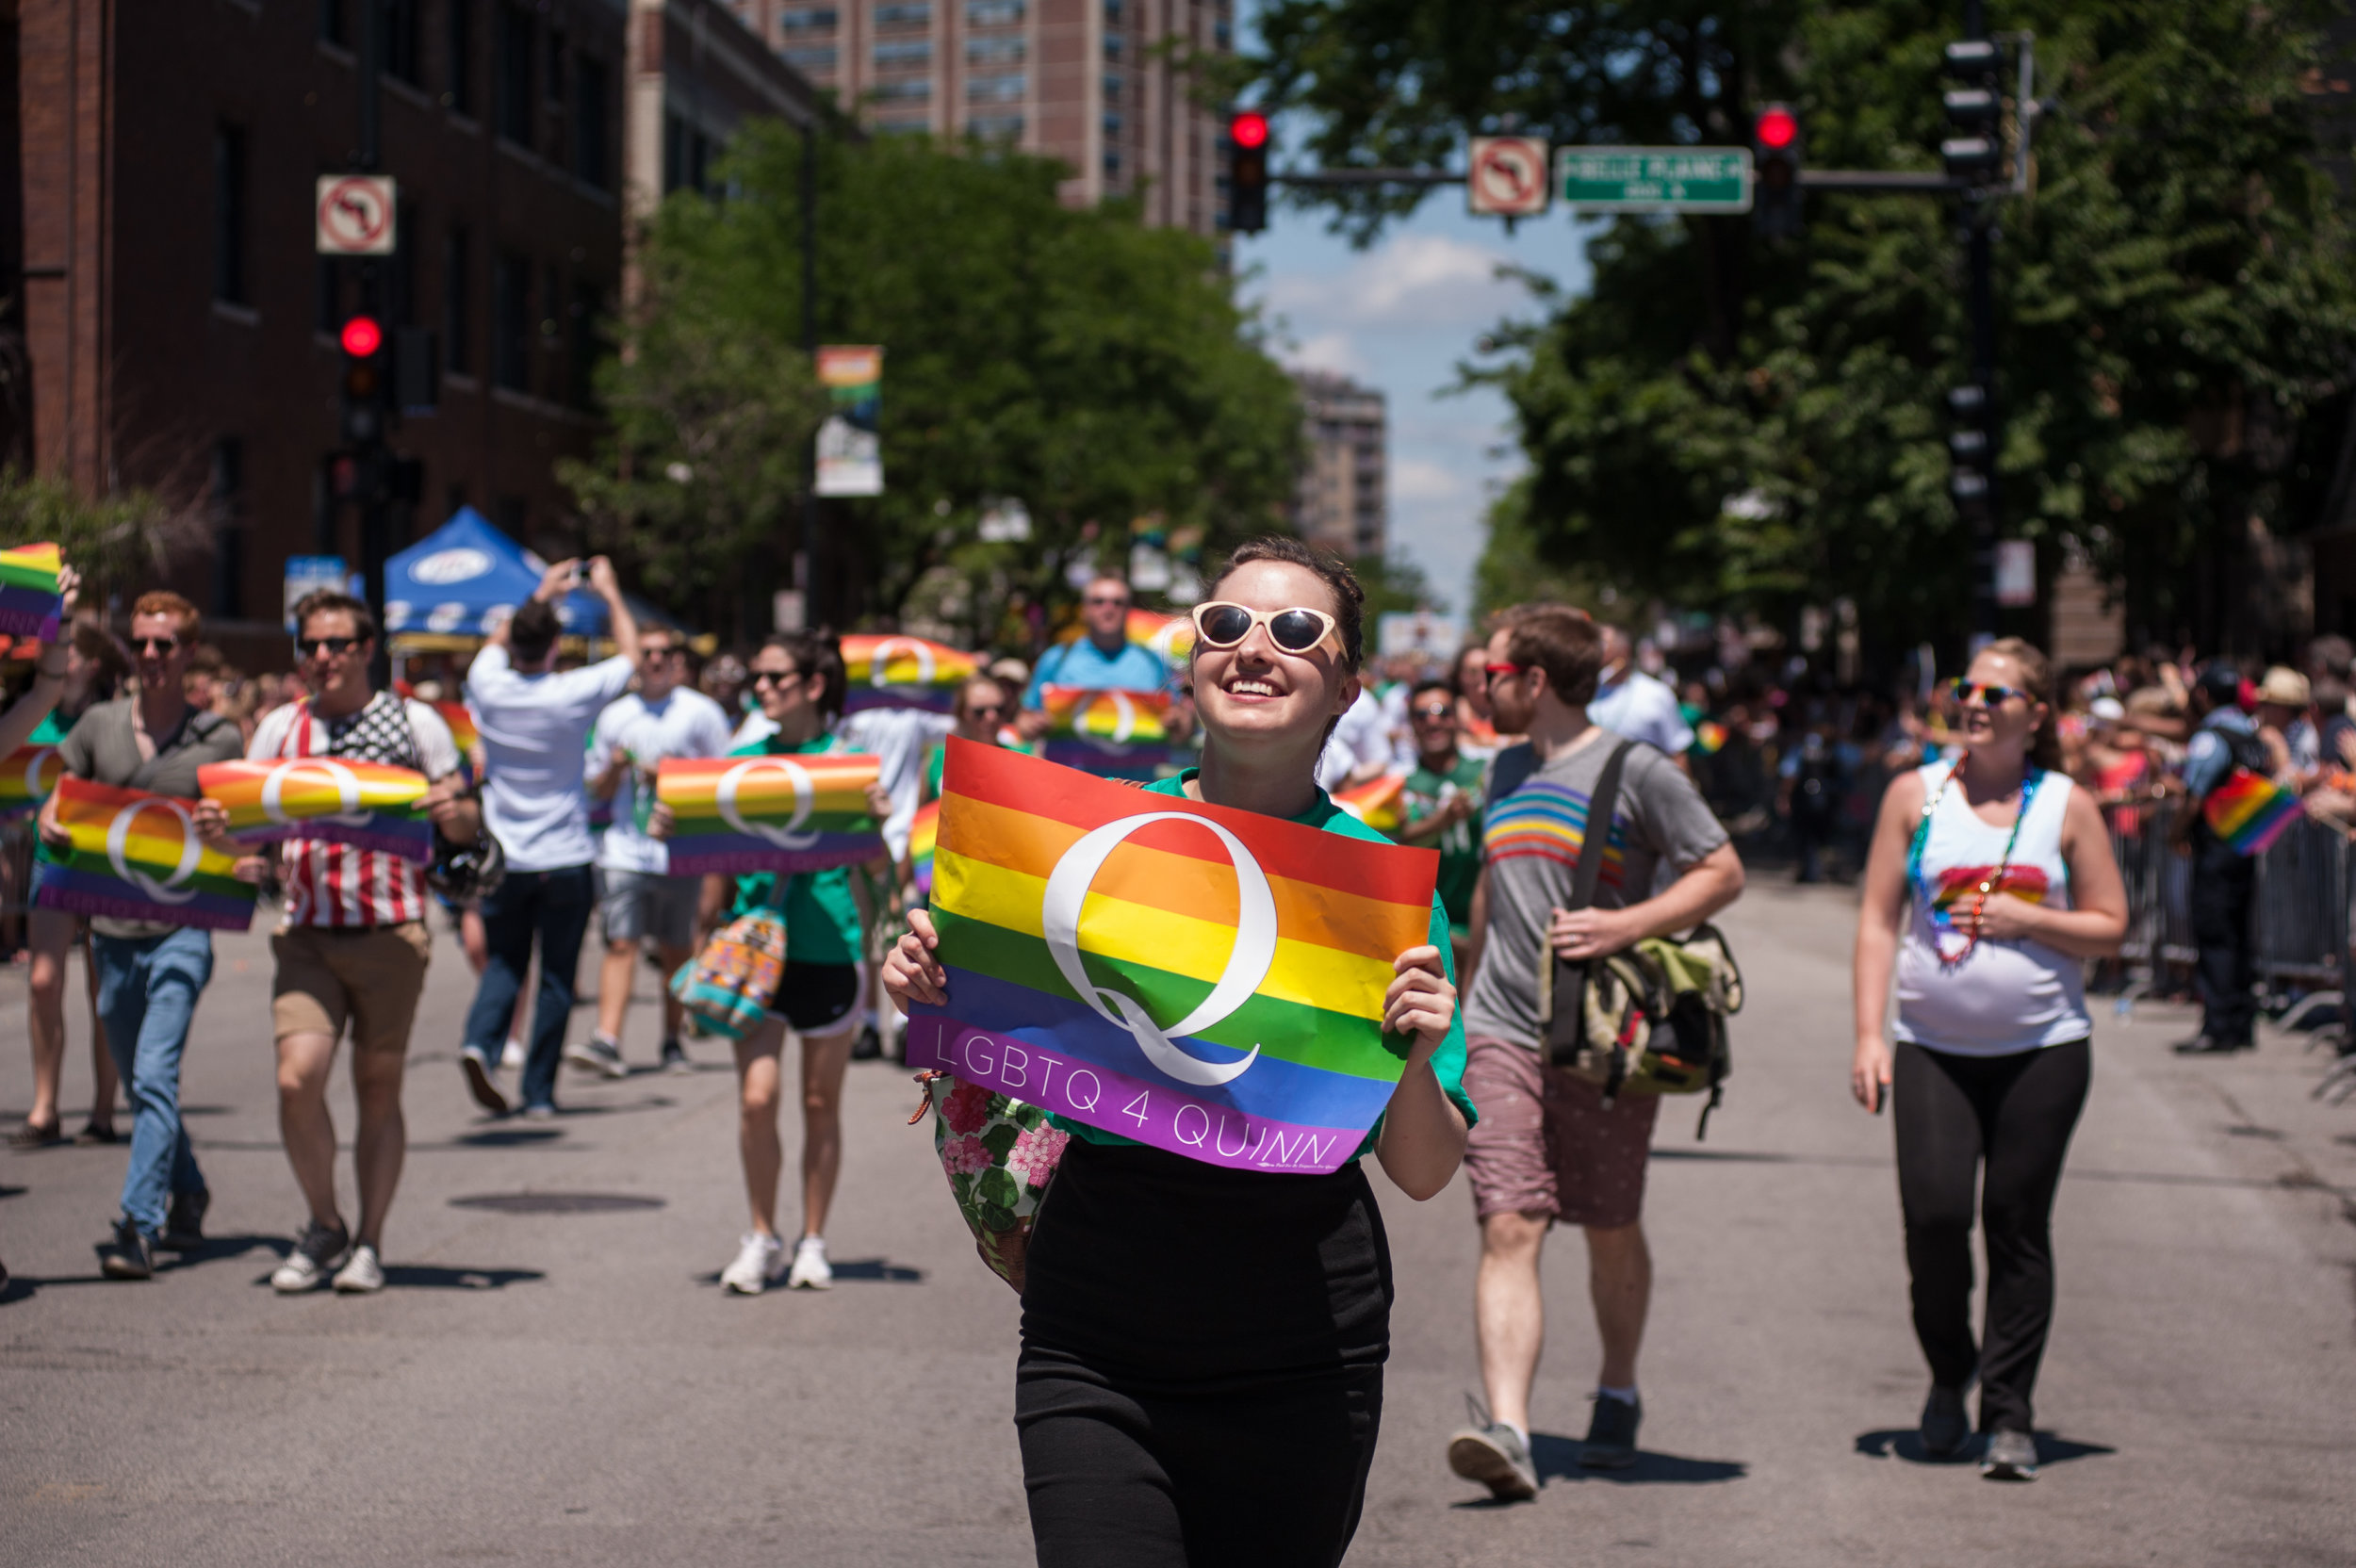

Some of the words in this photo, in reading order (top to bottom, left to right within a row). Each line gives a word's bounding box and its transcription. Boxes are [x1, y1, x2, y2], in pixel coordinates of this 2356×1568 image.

[106, 796, 203, 906] Q
[716, 757, 823, 851] Q
[1042, 810, 1278, 1086] Q
[937, 1023, 1101, 1113] LGBTQ
[1121, 1089, 1150, 1128] 4
[1174, 1103, 1337, 1165] QUINN
